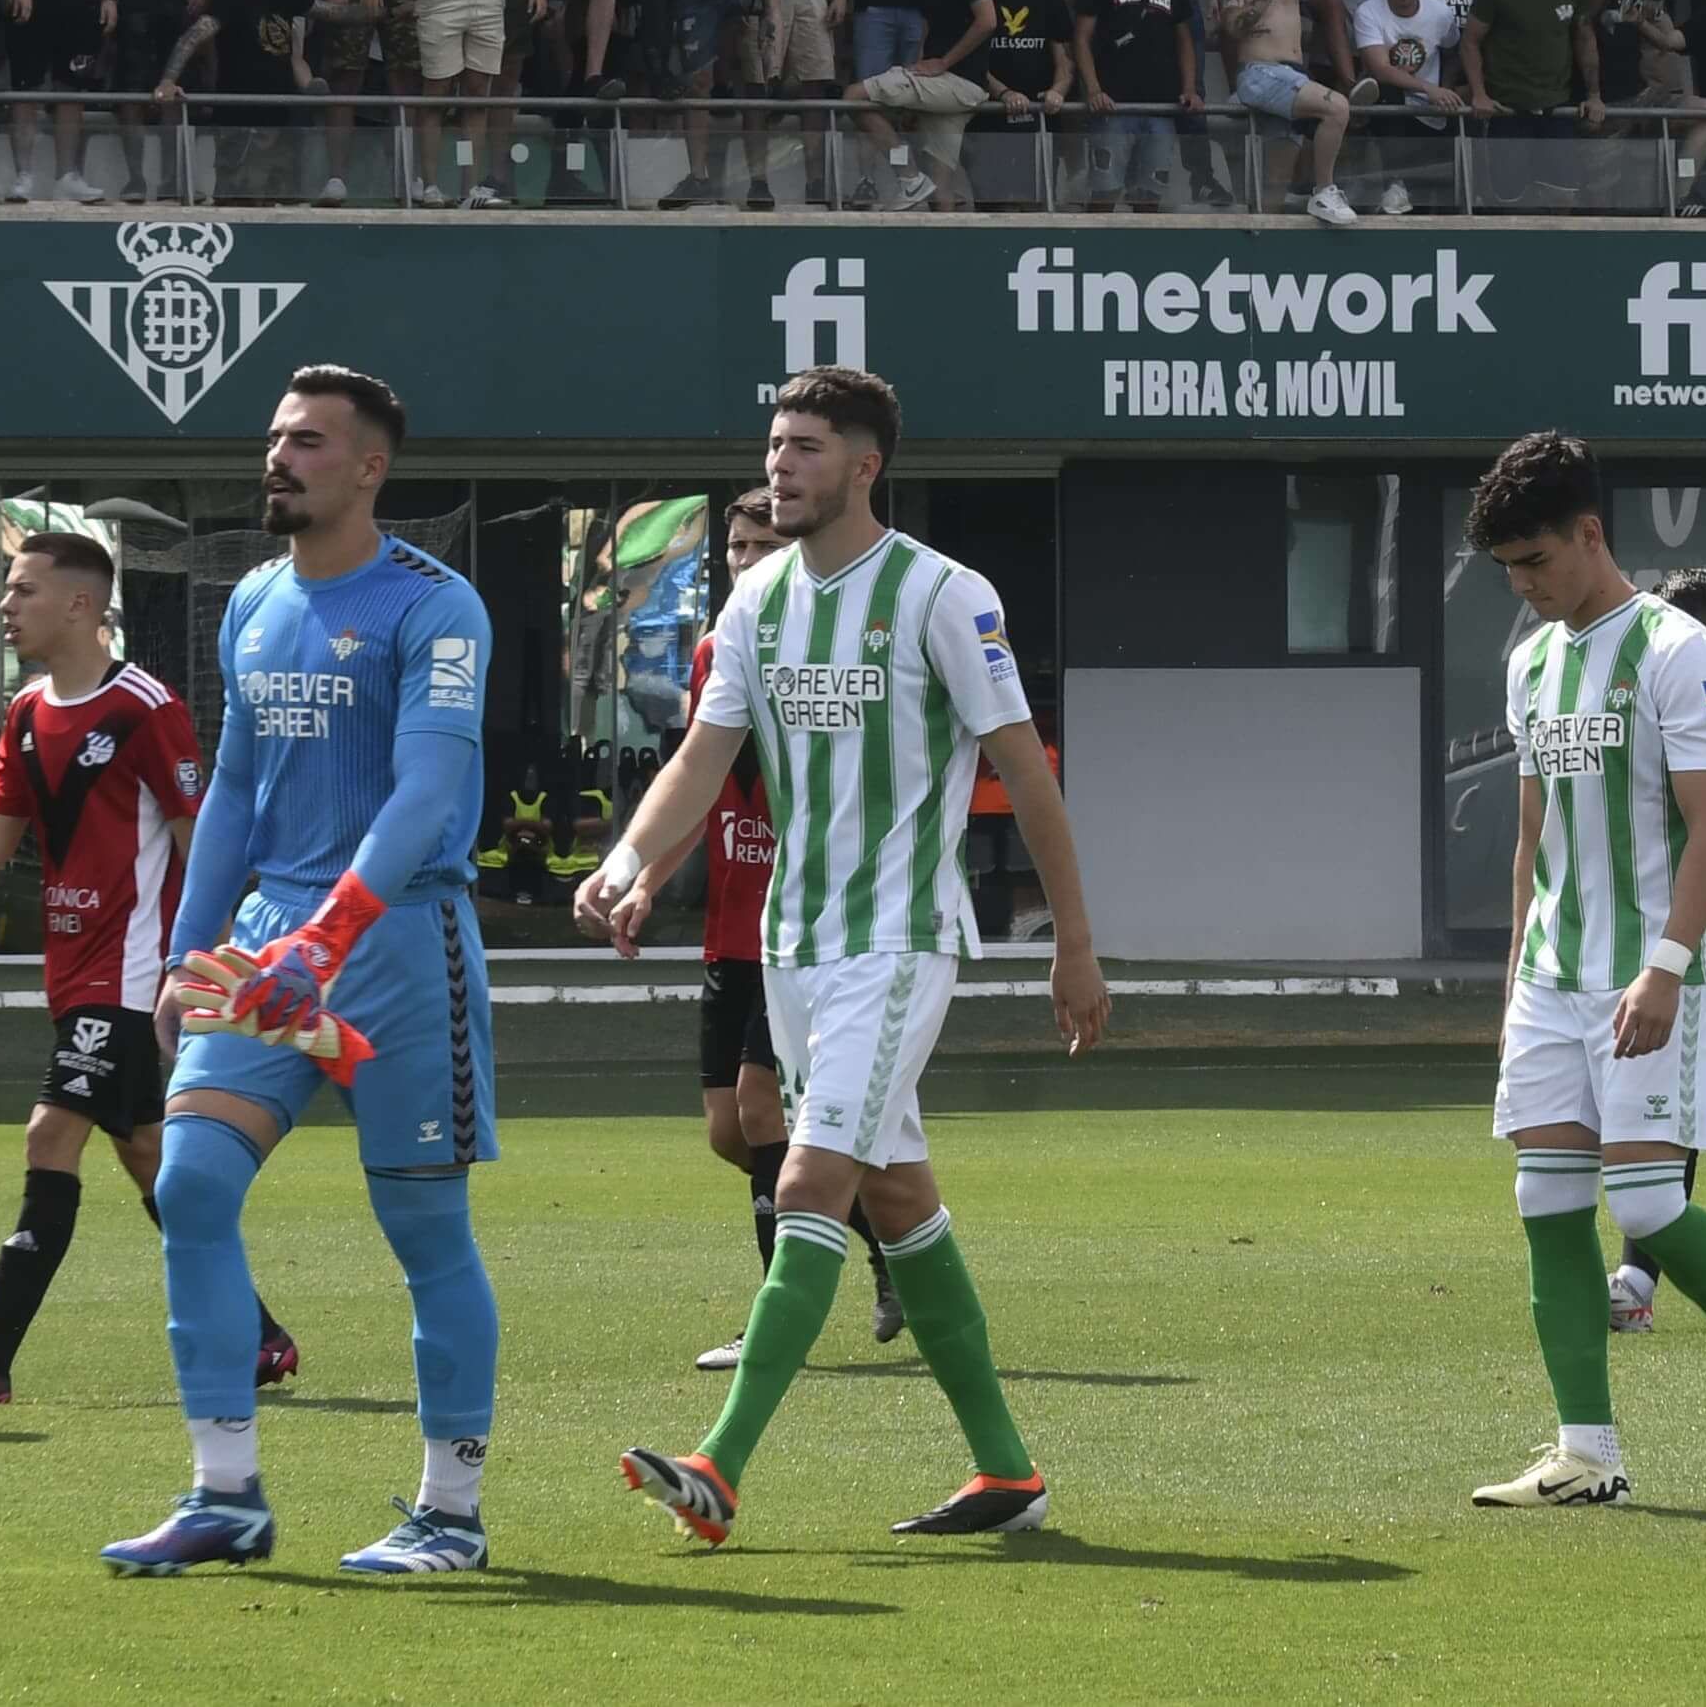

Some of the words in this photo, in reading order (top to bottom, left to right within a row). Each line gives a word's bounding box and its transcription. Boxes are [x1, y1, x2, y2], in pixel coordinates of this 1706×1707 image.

[1008, 247, 1498, 333] finetwork
[772, 257, 866, 374] fi
[1104, 360, 1226, 416] FIBRA
[1236, 359, 1268, 418] &
[1277, 349, 1404, 417] MÓVIL
[241, 671, 354, 707] FOREVER
[763, 666, 879, 697] FOREVER
[255, 707, 329, 738] GREEN
[780, 700, 862, 727] GREEN
[1528, 716, 1621, 749] FOREVER
[1539, 744, 1602, 776] GREEN
